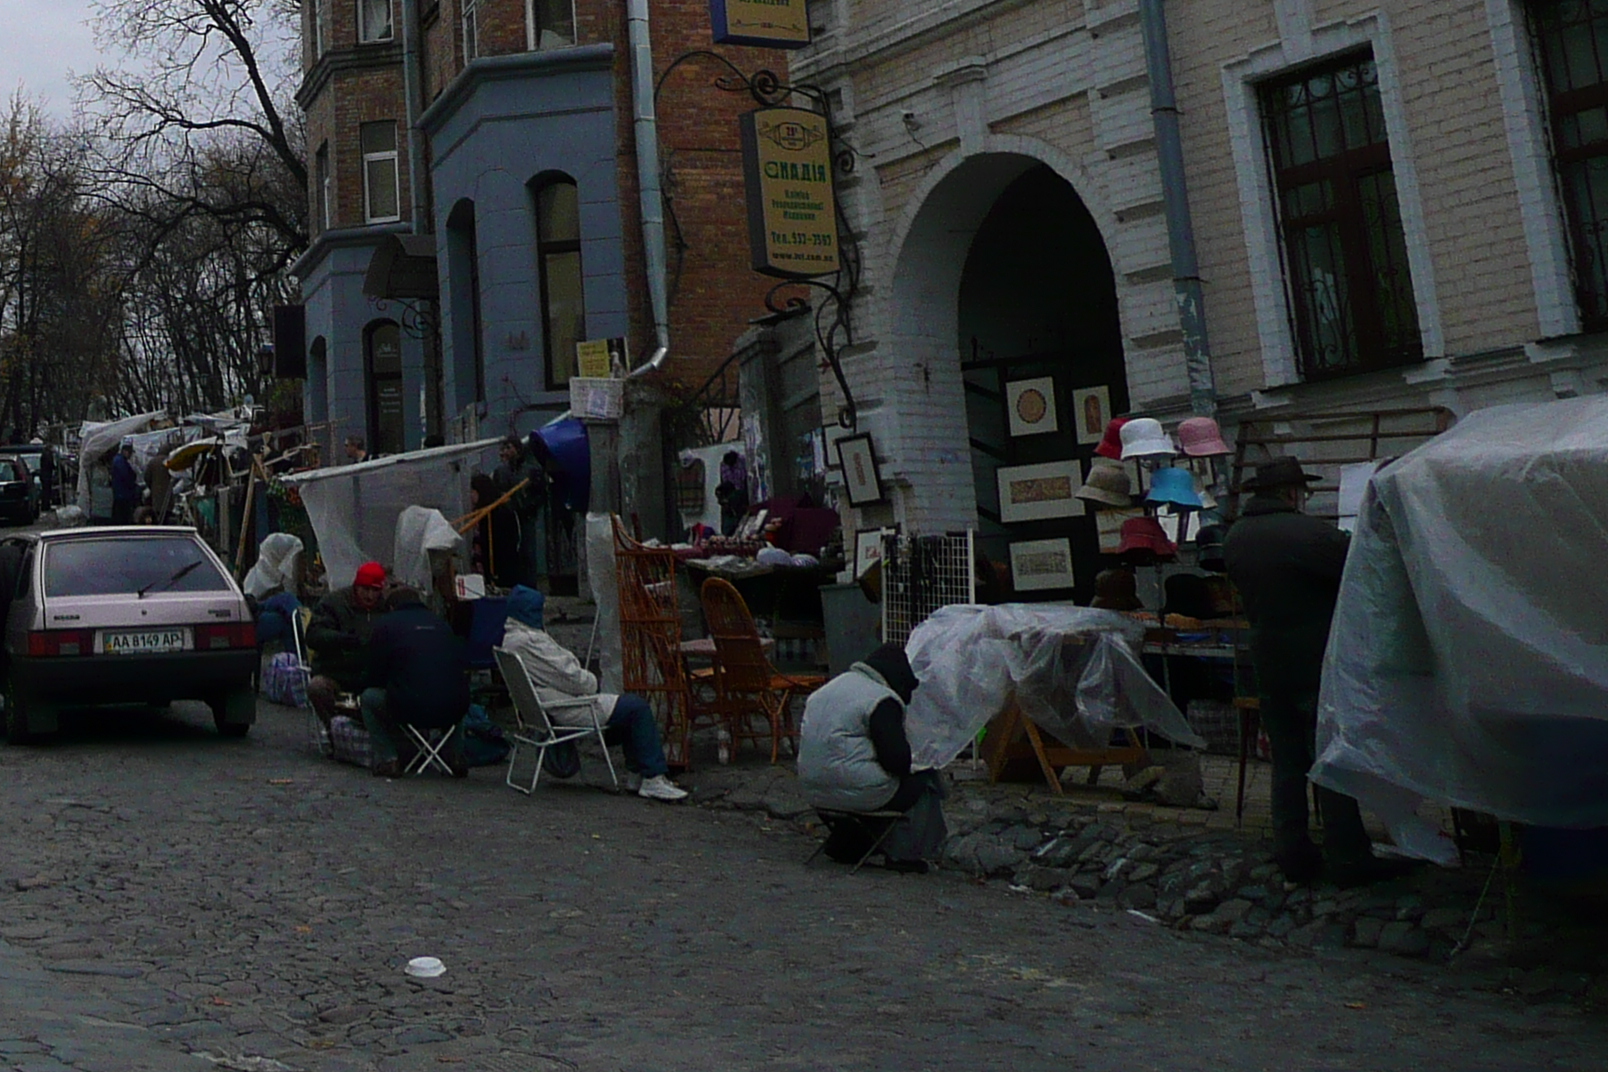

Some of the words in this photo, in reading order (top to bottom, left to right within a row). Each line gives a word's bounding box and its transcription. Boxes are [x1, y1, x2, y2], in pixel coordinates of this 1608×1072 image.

[112, 635, 130, 649] AA
[132, 634, 159, 648] 8149
[163, 634, 180, 647] AP
